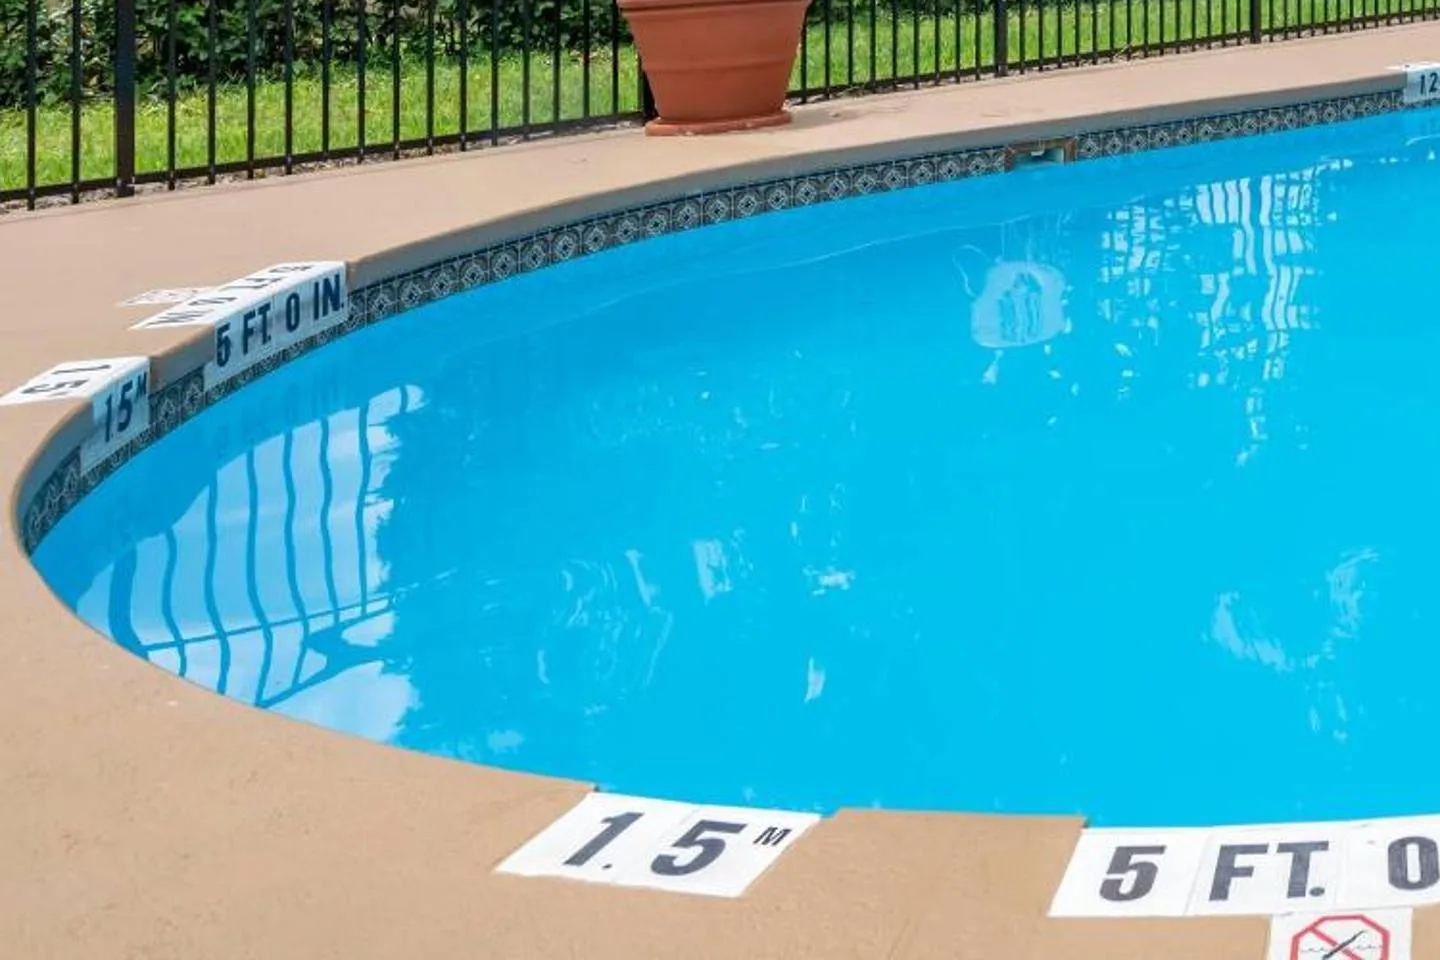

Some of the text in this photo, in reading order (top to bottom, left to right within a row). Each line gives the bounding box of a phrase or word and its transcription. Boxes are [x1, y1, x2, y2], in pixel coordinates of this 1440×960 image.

[215, 322, 232, 367] 5
[285, 292, 300, 333] 0
[1098, 844, 1167, 902] 5
[1207, 840, 1331, 902] FT.
